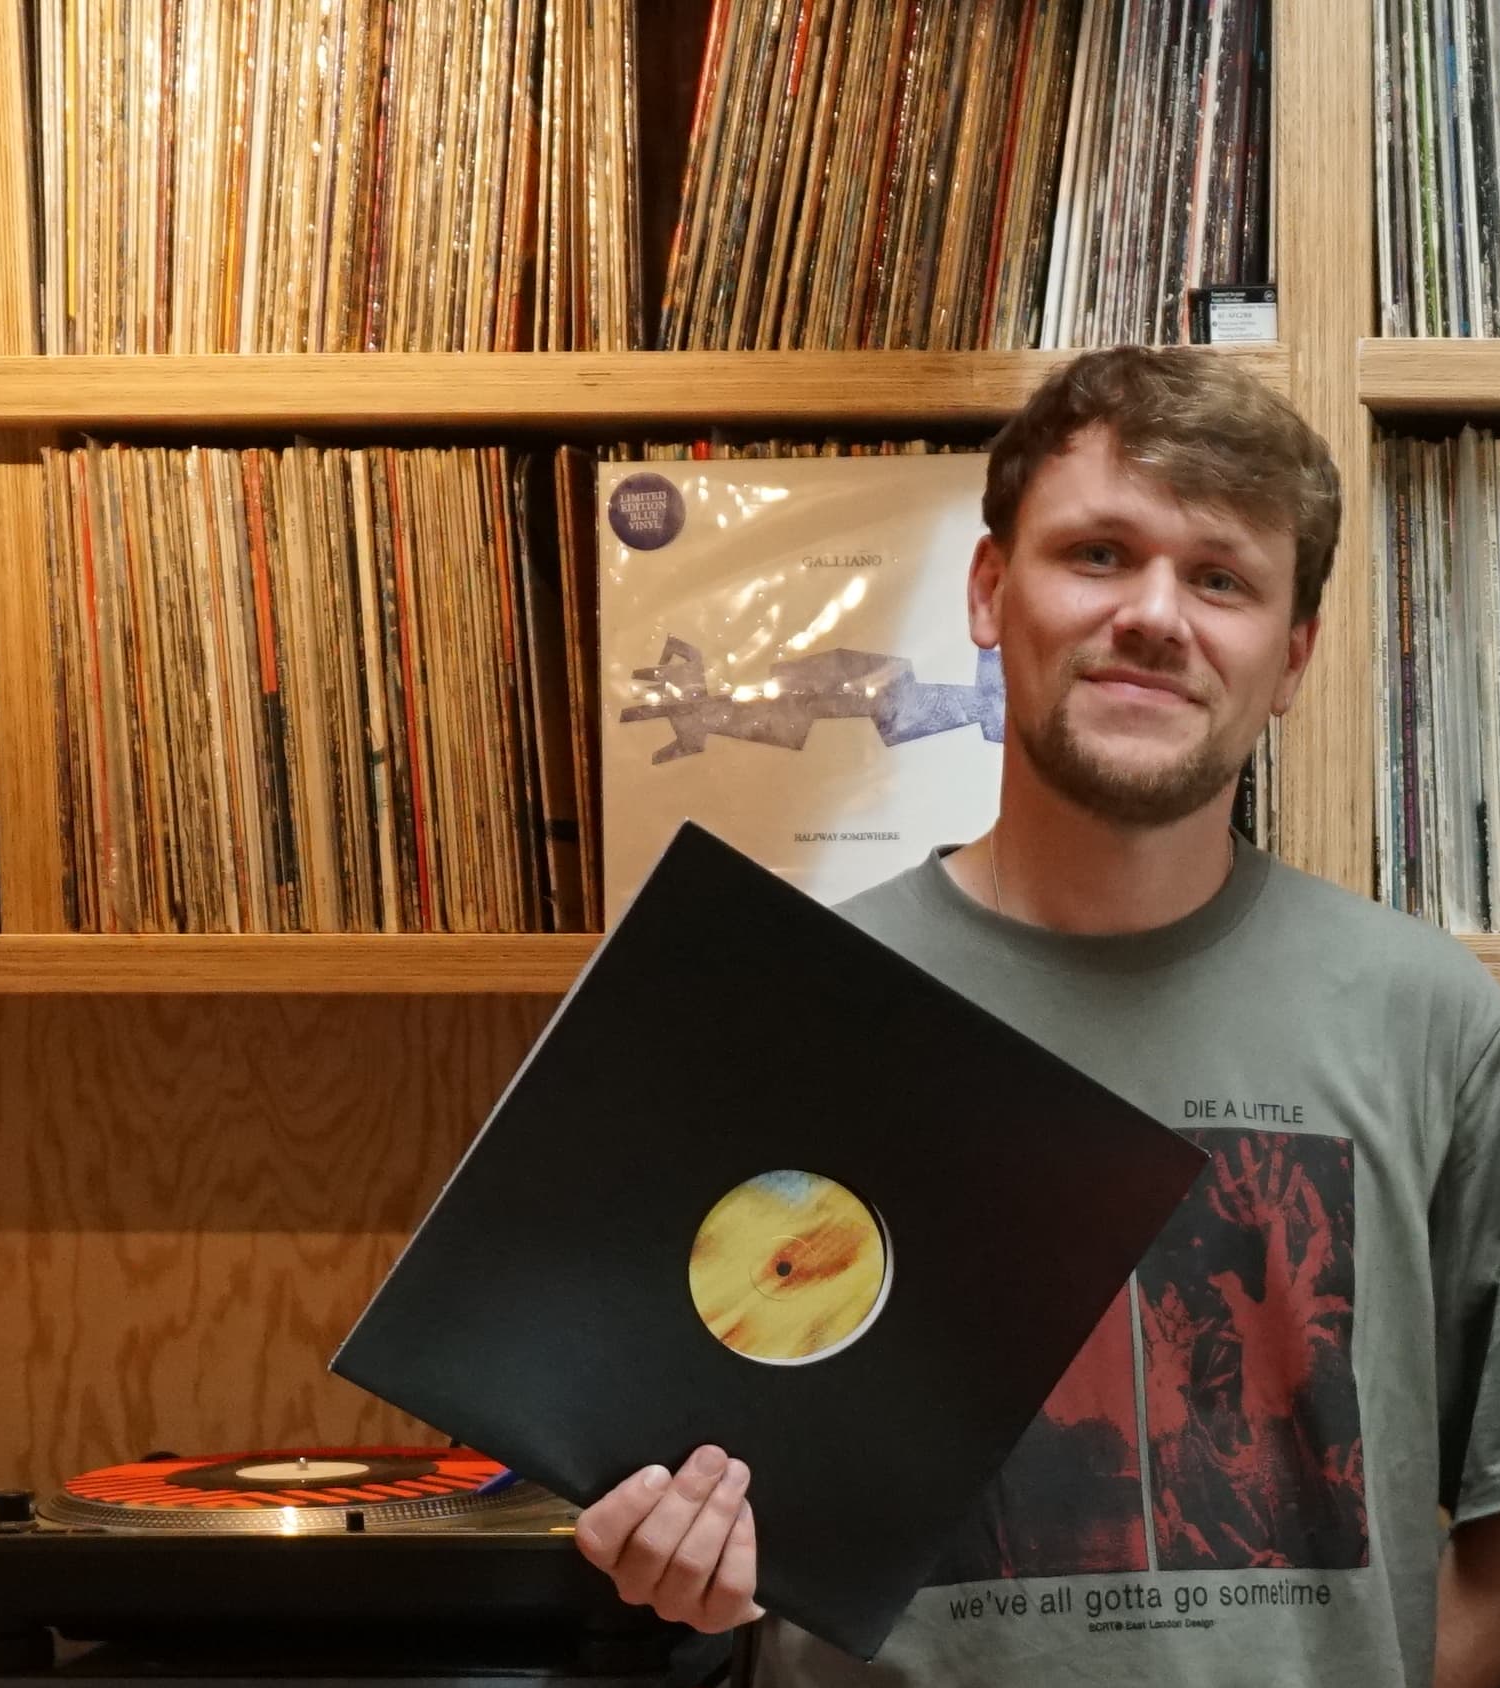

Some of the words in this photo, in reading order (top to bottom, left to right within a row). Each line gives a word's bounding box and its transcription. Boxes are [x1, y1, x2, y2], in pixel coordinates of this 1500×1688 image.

[620, 491, 667, 502] LIMITED
[620, 501, 667, 512] EDITION
[628, 520, 662, 531] VINYL
[802, 555, 882, 568] GALLIANO
[840, 832, 900, 841] SOMEWHERE
[1184, 1099, 1216, 1118] DIE
[1224, 1100, 1237, 1118] A
[1243, 1102, 1304, 1124] LITTLE
[950, 1590, 1028, 1621] we've
[1040, 1586, 1072, 1615] all
[1086, 1583, 1163, 1617] gotta
[1175, 1584, 1208, 1613] go
[1219, 1578, 1332, 1607] sometime
